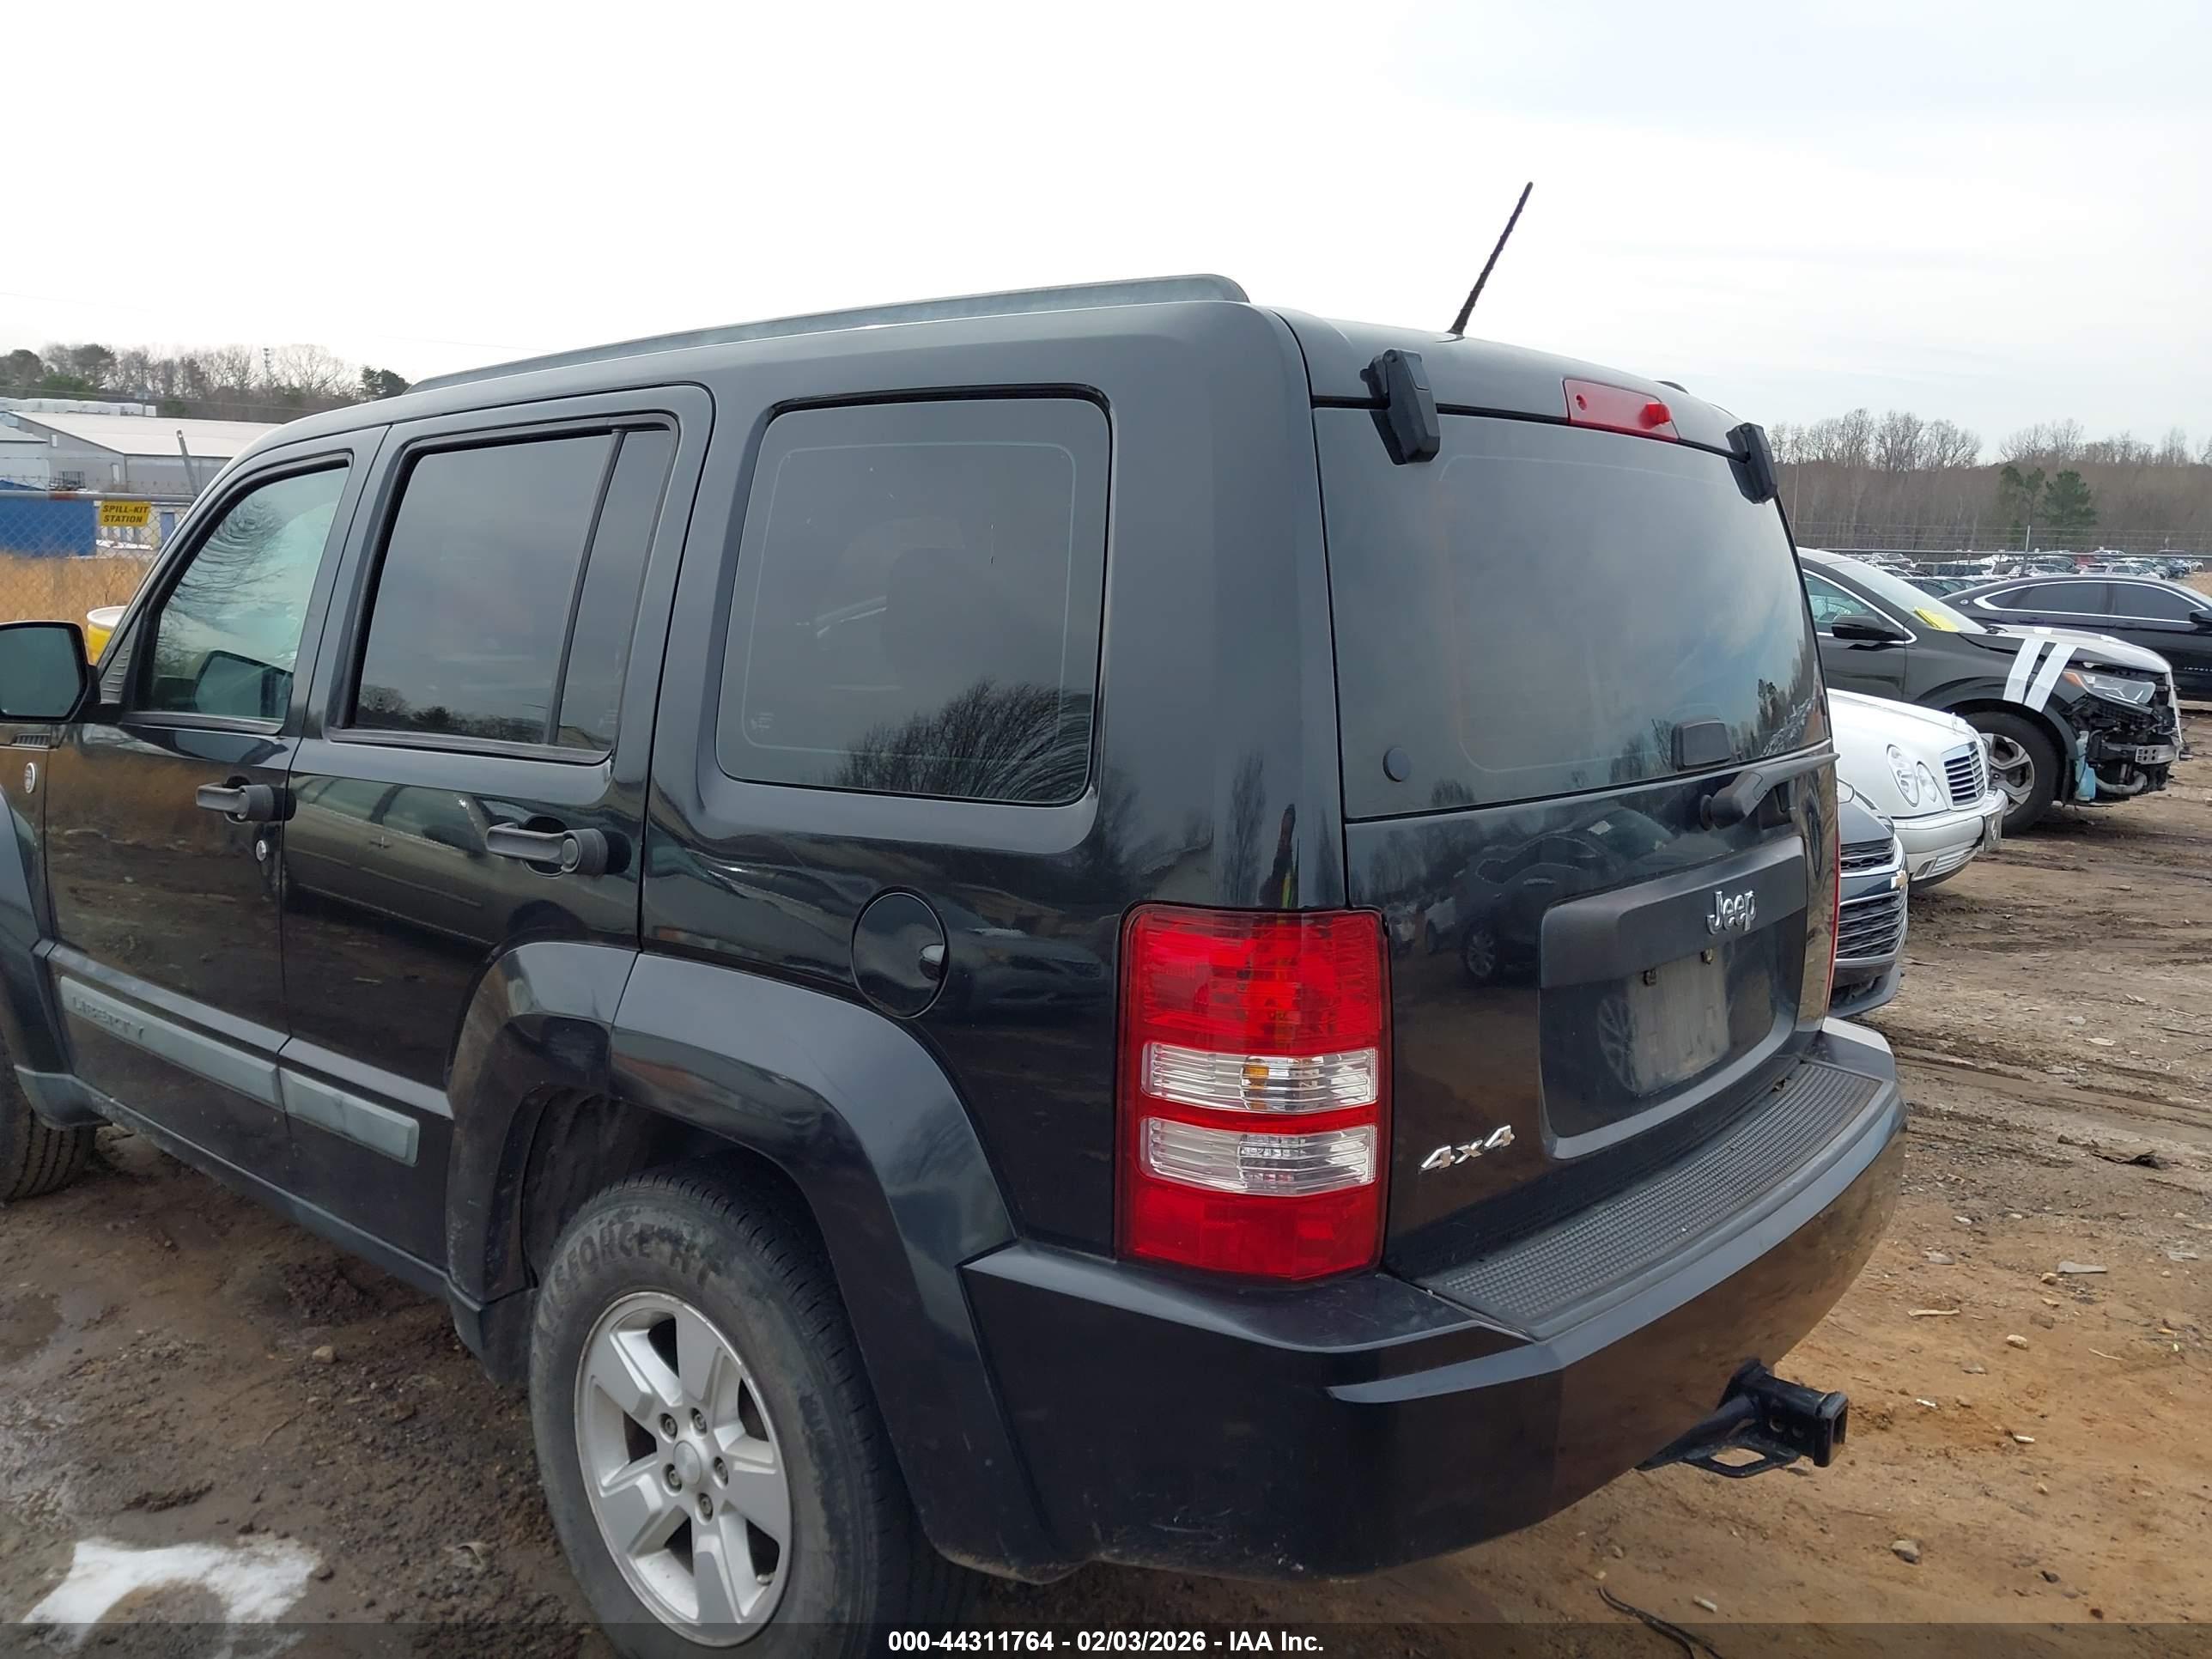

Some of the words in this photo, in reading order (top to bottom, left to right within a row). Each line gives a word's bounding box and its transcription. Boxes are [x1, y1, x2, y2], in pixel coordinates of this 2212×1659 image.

[102, 504, 149, 514] SPILL-KIT
[103, 514, 143, 523] STATION
[1705, 890, 1757, 935] Jeep
